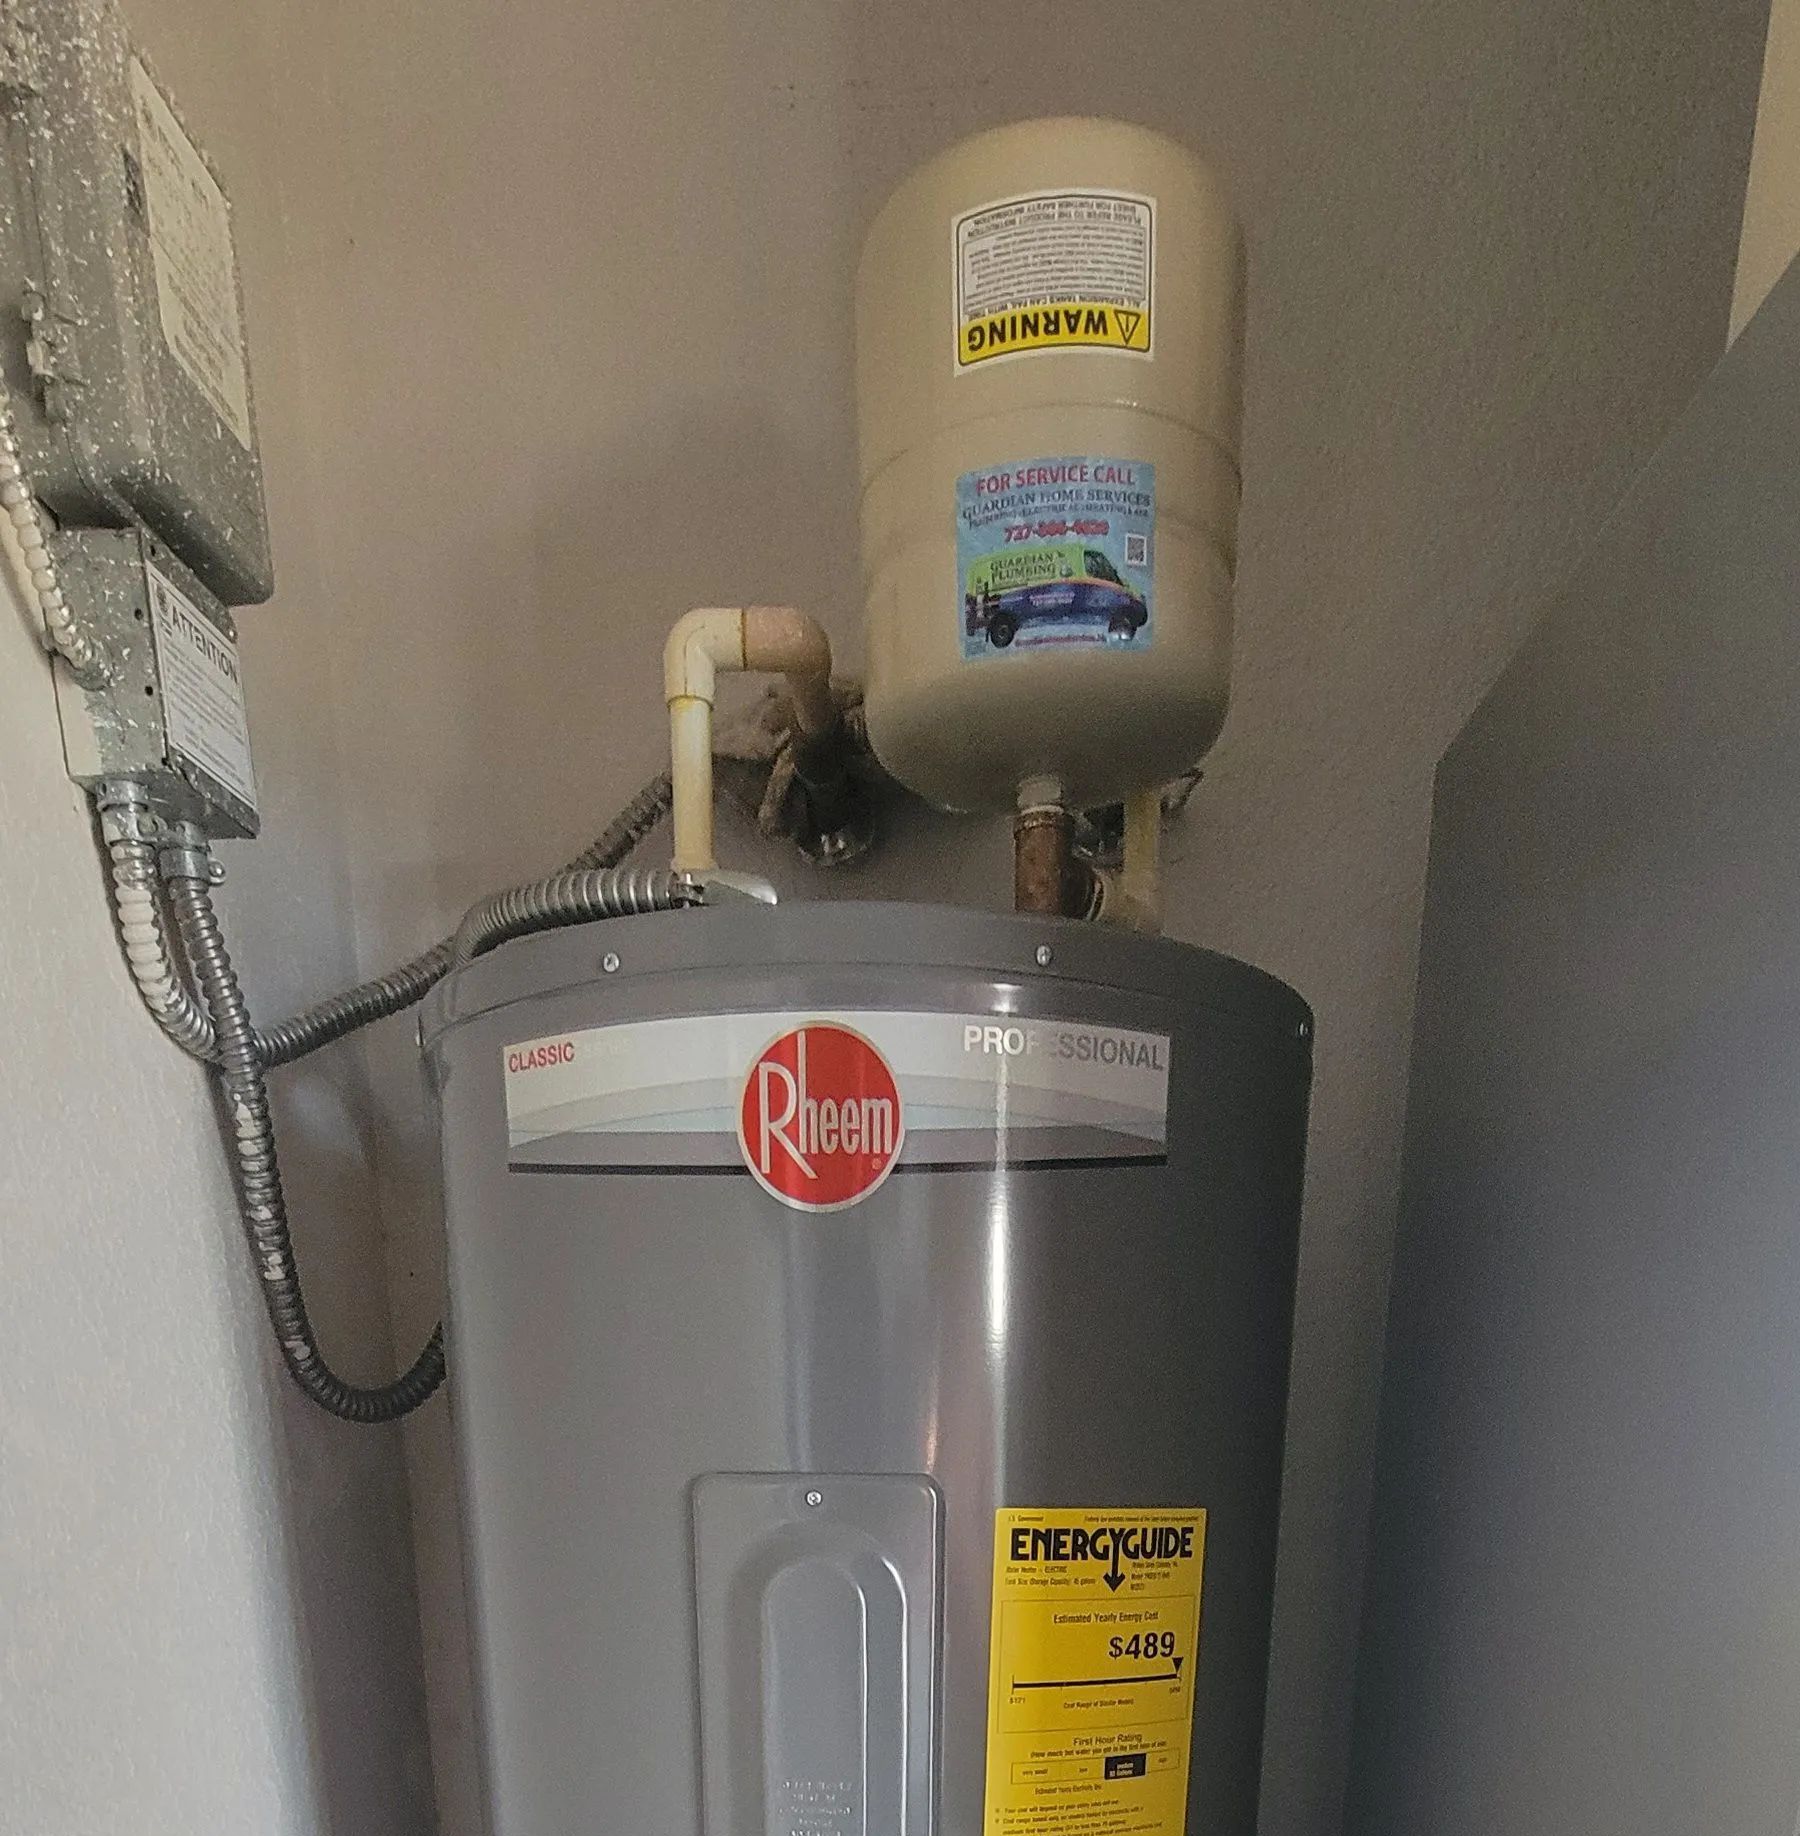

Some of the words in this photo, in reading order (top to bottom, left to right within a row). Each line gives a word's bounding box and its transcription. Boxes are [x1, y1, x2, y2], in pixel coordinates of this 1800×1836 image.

[1029, 296, 1046, 306] CAN
[967, 309, 1108, 352] WARNING
[975, 473, 1011, 496] FOR
[1016, 464, 1089, 488] SERVICE
[1094, 465, 1136, 485] CALL
[963, 492, 1035, 520] GUARDIAN
[1087, 489, 1151, 506] SERVICES
[172, 605, 239, 685] ATTENTION
[508, 1042, 575, 1073] CLASSIC
[758, 1030, 893, 1179] Rheem
[1010, 1526, 1194, 1561] ENERGYGUIDE
[1054, 1614, 1091, 1624] Estimated
[1094, 1613, 1117, 1624] Yearly
[1119, 1612, 1143, 1623] Energy
[1145, 1611, 1158, 1619] Cost
[1109, 1631, 1175, 1660] $489
[1073, 1737, 1093, 1746] First
[1095, 1735, 1115, 1745] Hour
[1118, 1733, 1142, 1743] Rating
